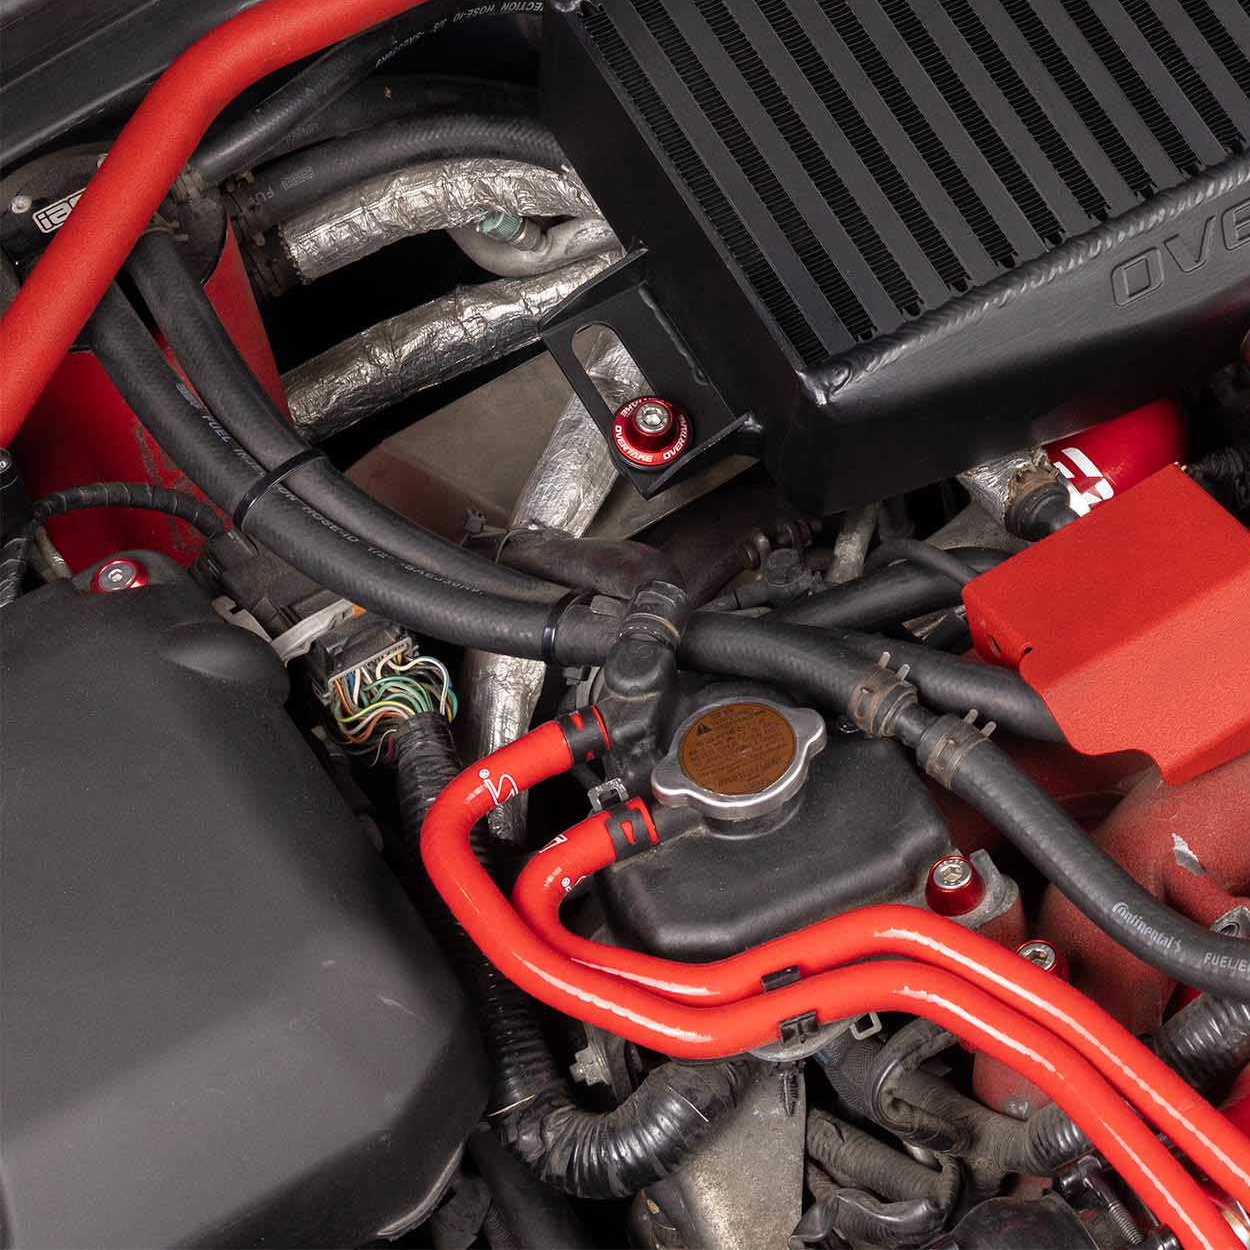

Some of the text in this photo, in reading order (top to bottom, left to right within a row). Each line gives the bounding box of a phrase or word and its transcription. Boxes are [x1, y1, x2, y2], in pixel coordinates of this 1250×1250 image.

[203, 414, 231, 443] FUEL
[615, 425, 653, 462] OVERTAKE
[1111, 901, 1176, 949] Continental
